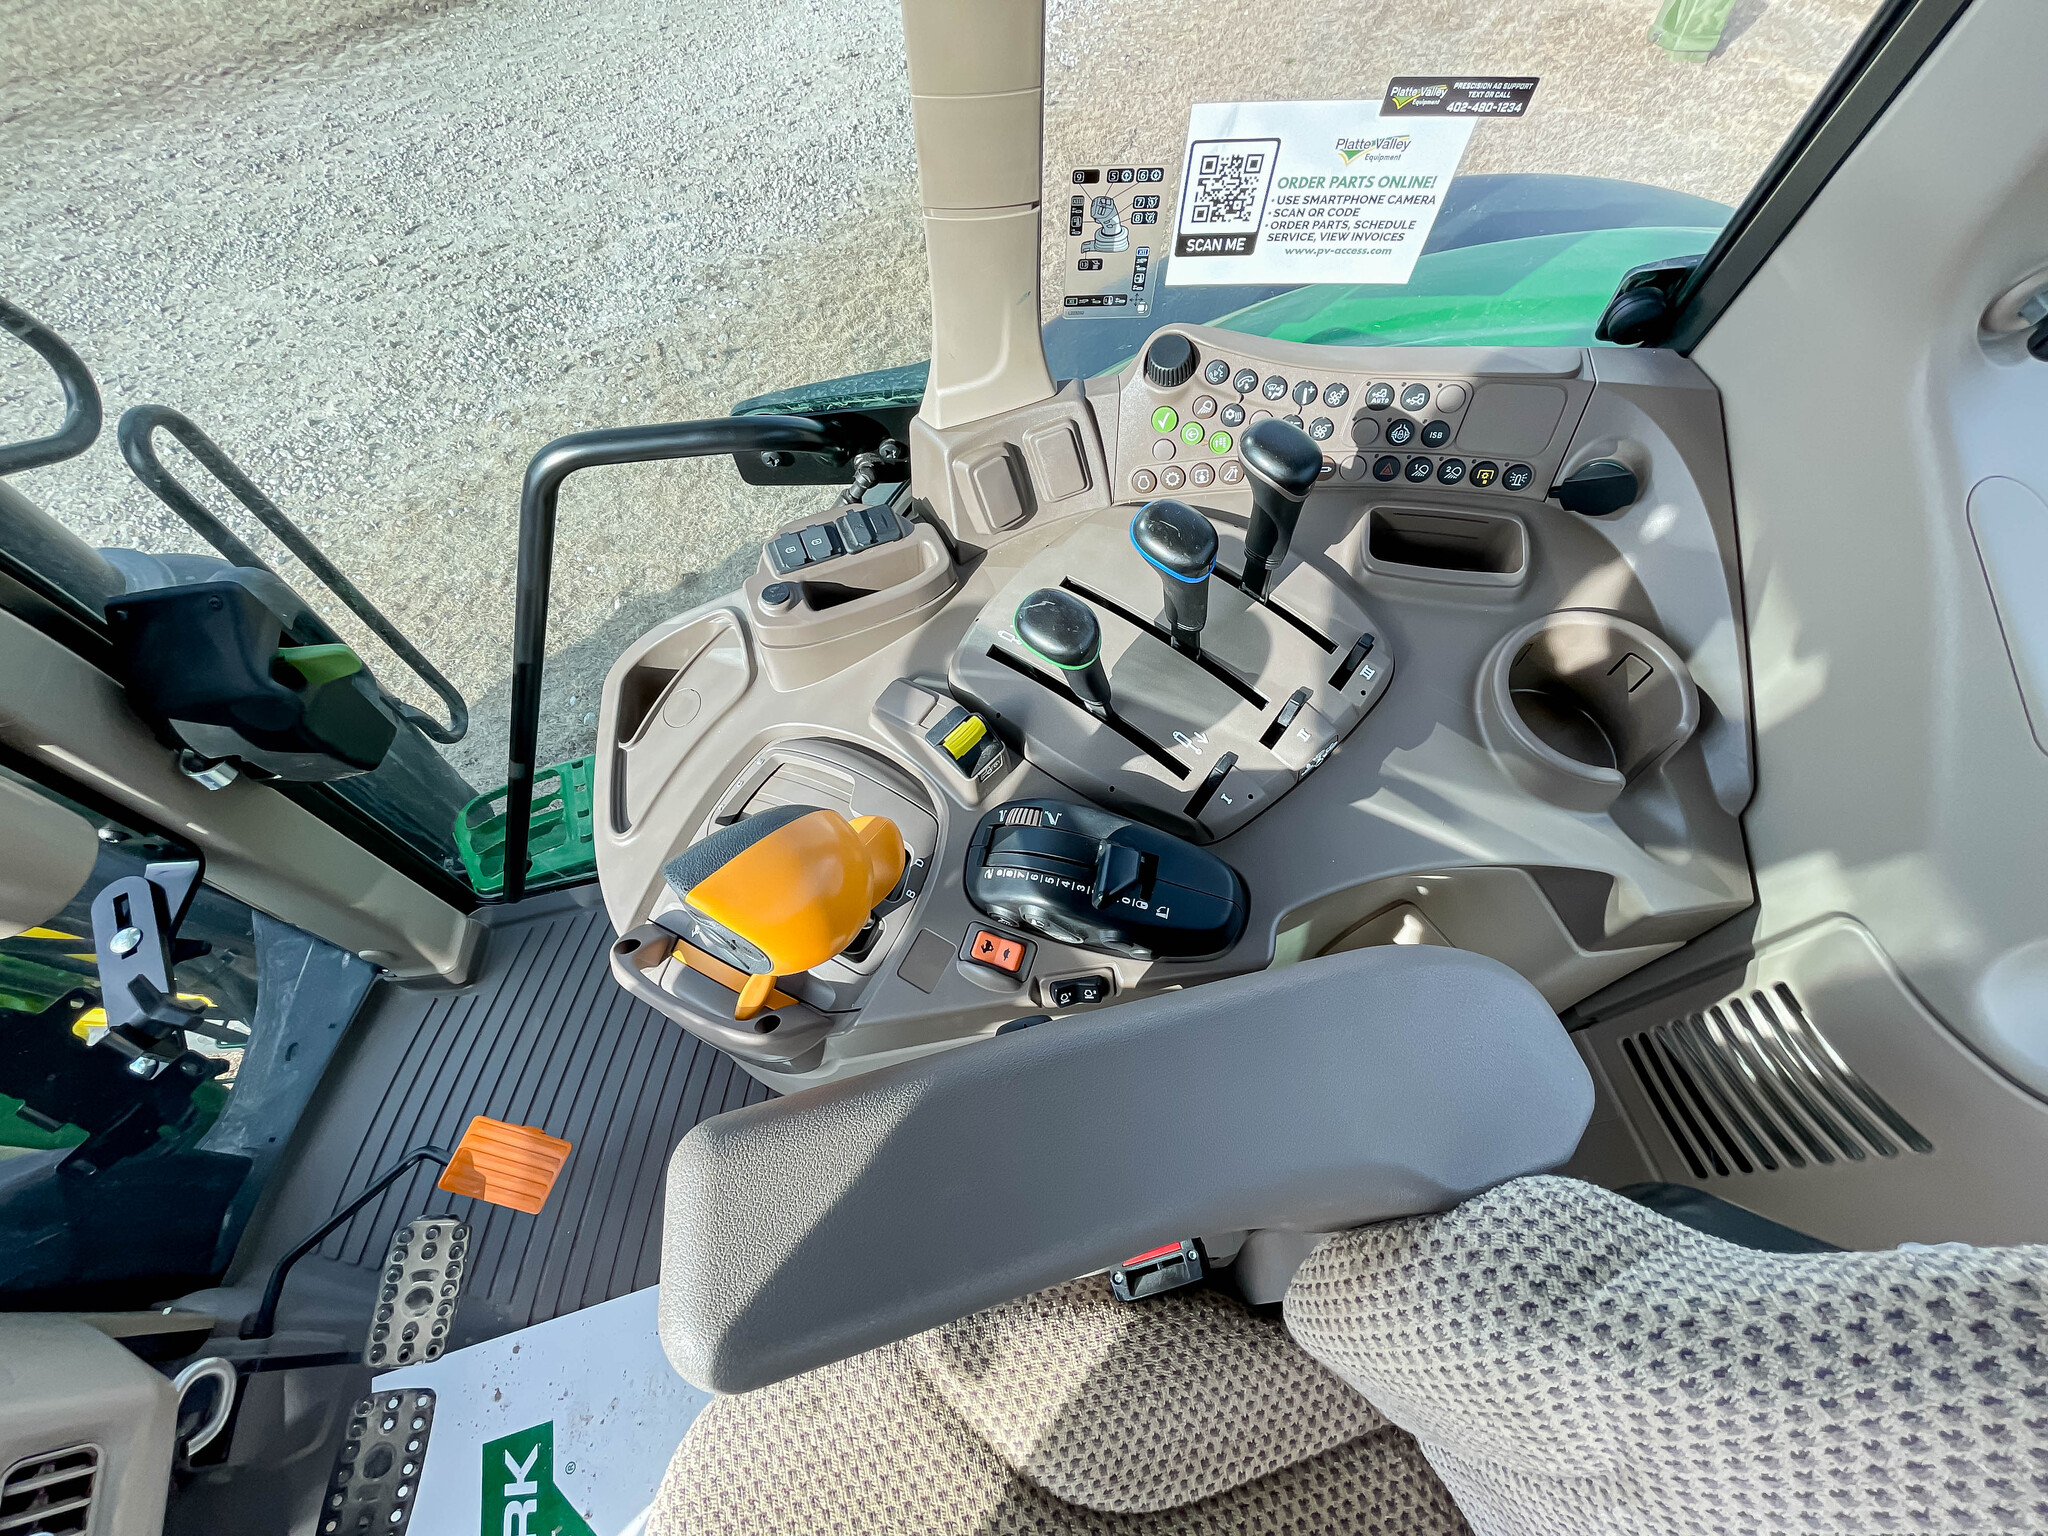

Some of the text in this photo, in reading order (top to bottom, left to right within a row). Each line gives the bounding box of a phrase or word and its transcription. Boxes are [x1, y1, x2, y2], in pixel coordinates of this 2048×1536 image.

[1502, 82, 1533, 90] SUPPORT
[1390, 86, 1448, 99] Platte Valley
[1446, 101, 1522, 113] 402-480-1234
[1335, 136, 1412, 152] Platte Valley
[1364, 153, 1401, 162] Equipment
[1277, 175, 1438, 189] ORDER PARTS ONLINE!
[1277, 194, 1436, 205] USE SMARTPHONE CAMERA
[1272, 207, 1361, 218] SCAN QR CODE
[1270, 220, 1417, 231] ORDER PARTS, SCHEDULE
[1266, 232, 1406, 243] SERVICE, VIEW INVOICES
[1185, 238, 1247, 252] SCAN ME
[1284, 248, 1393, 257] www.pv-access.com
[1429, 431, 1443, 439] ISB
[914, 858, 925, 868] D
[1030, 873, 1039, 881] 6
[1045, 876, 1054, 884] 5
[1061, 880, 1071, 888] 4
[1076, 884, 1086, 892] 3
[905, 889, 916, 899] B
